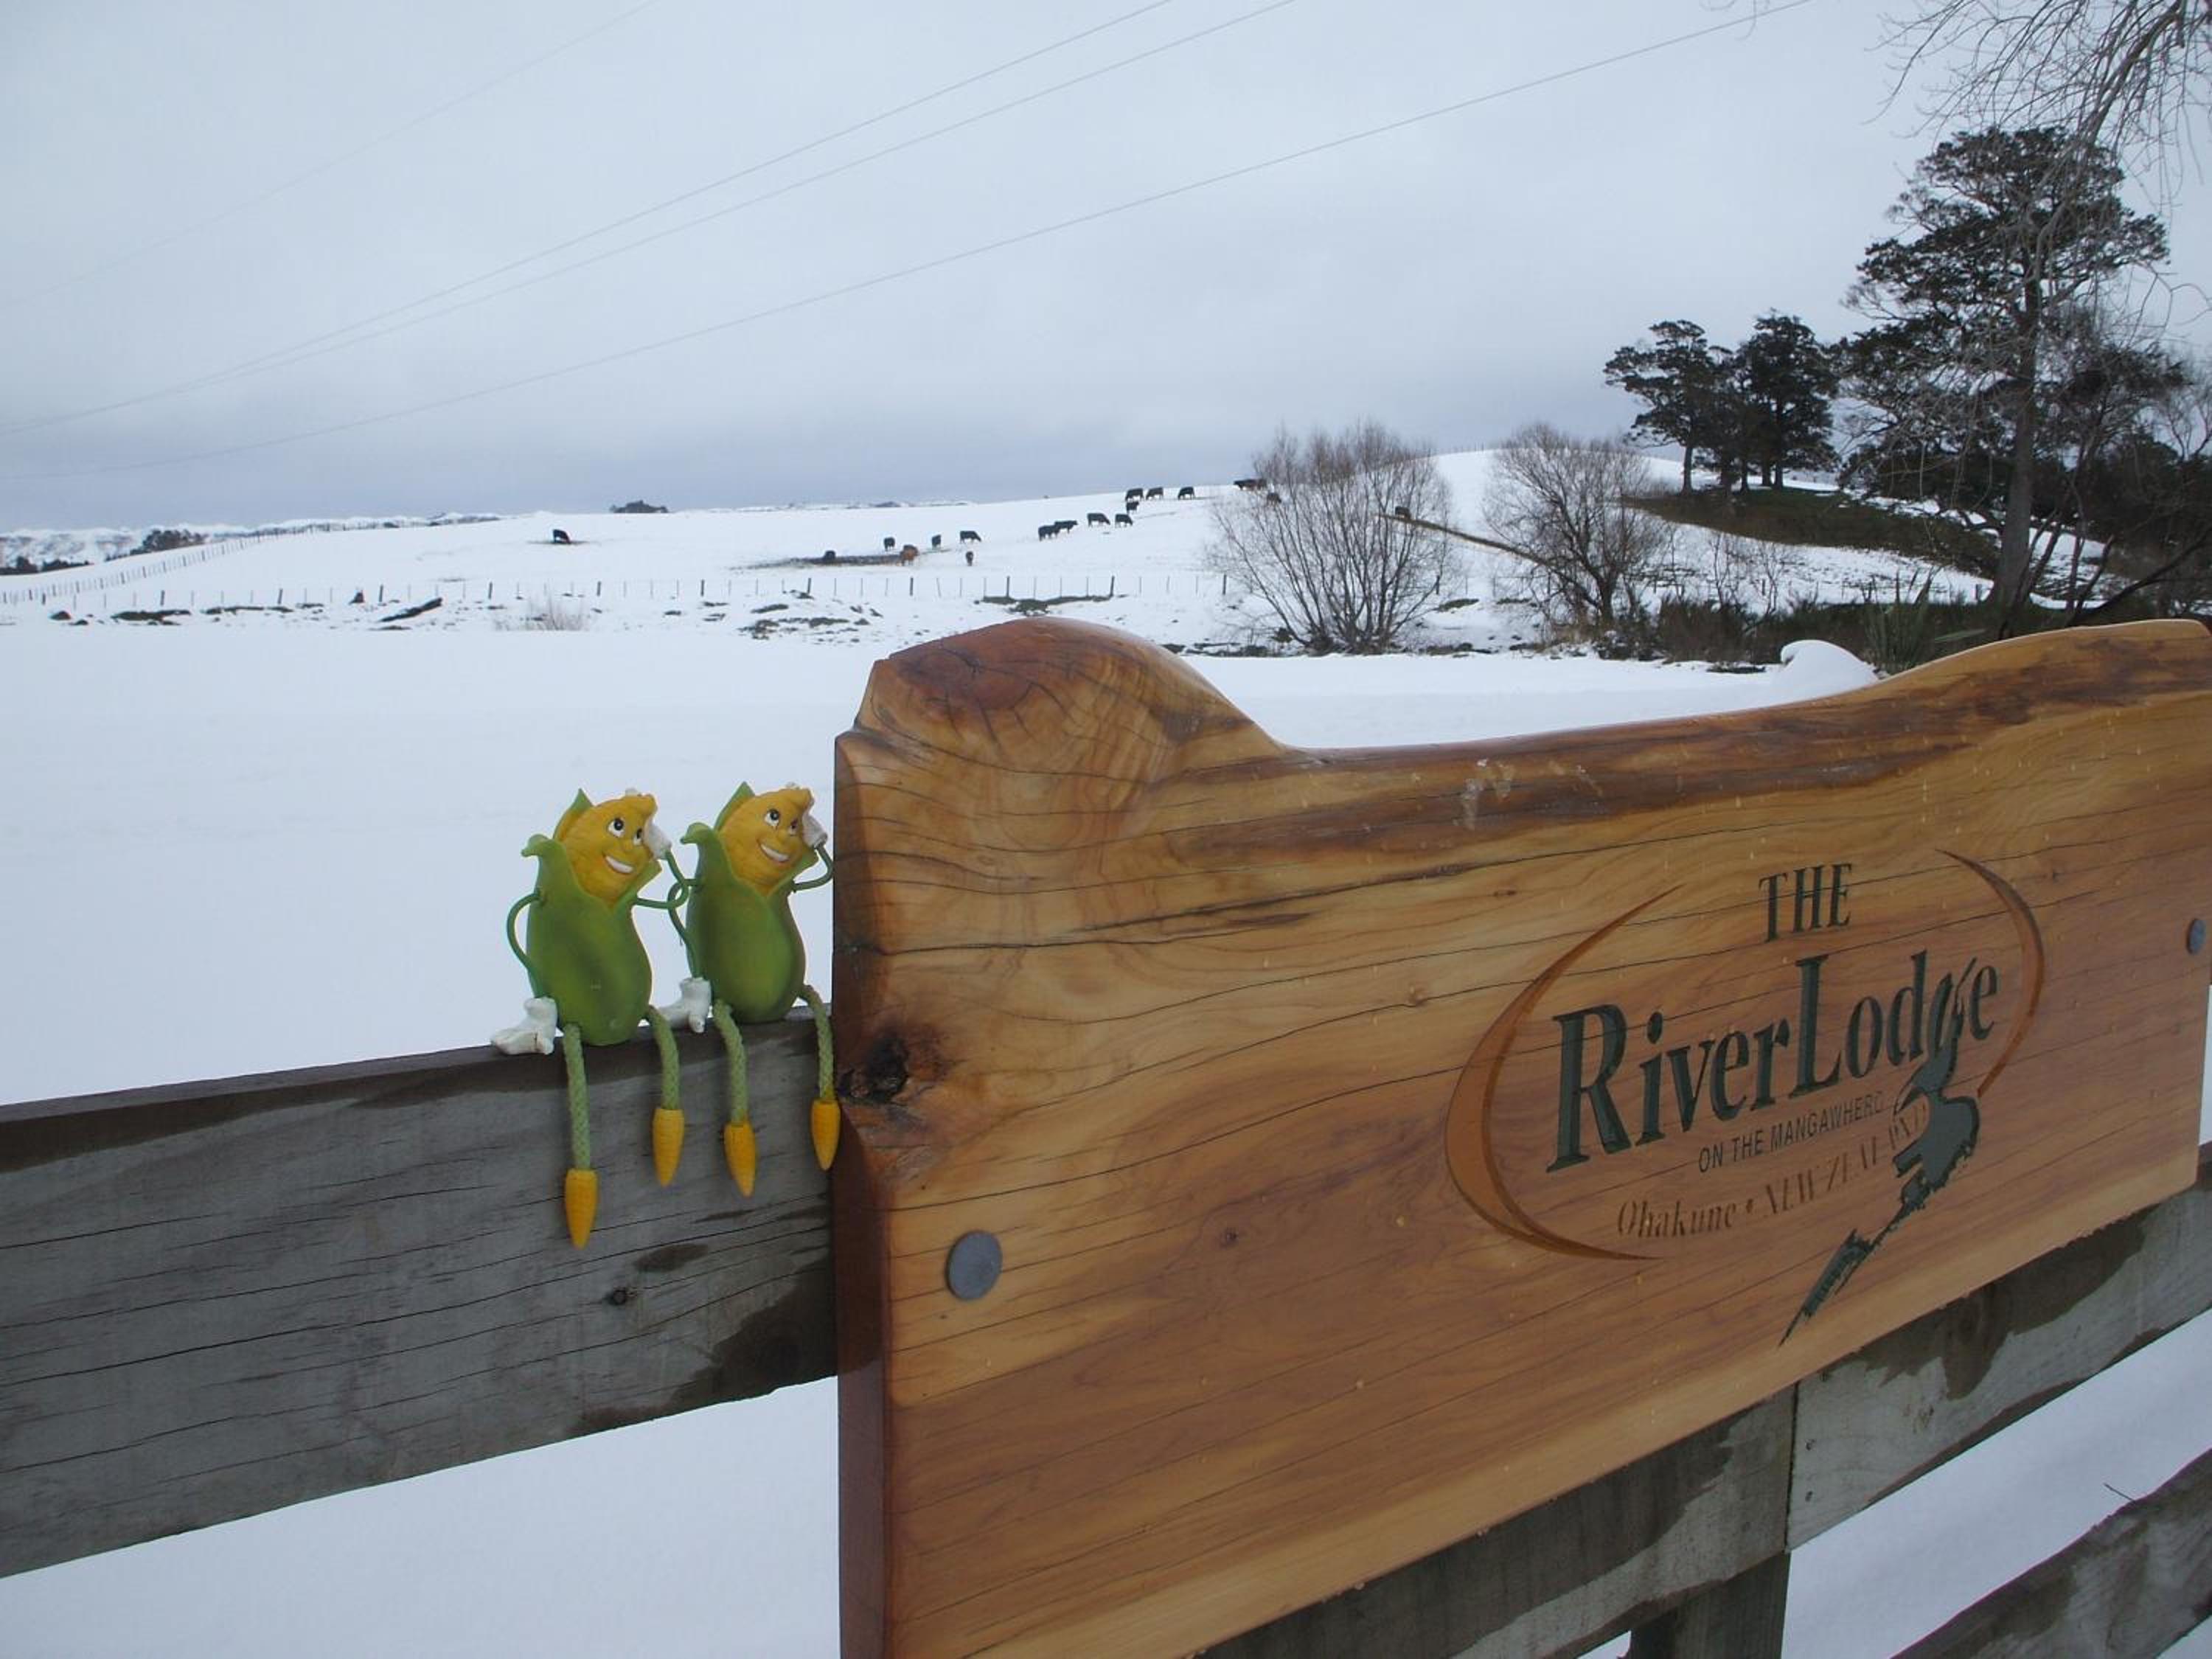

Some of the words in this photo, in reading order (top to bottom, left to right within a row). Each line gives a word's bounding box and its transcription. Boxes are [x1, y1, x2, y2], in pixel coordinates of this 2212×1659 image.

[1758, 863, 1852, 943] THE
[1546, 949, 2000, 1172] RiverLodge
[1698, 1142, 1724, 1173] ON
[1732, 1130, 1765, 1163] THE
[1618, 1200, 1736, 1237] Ohakune
